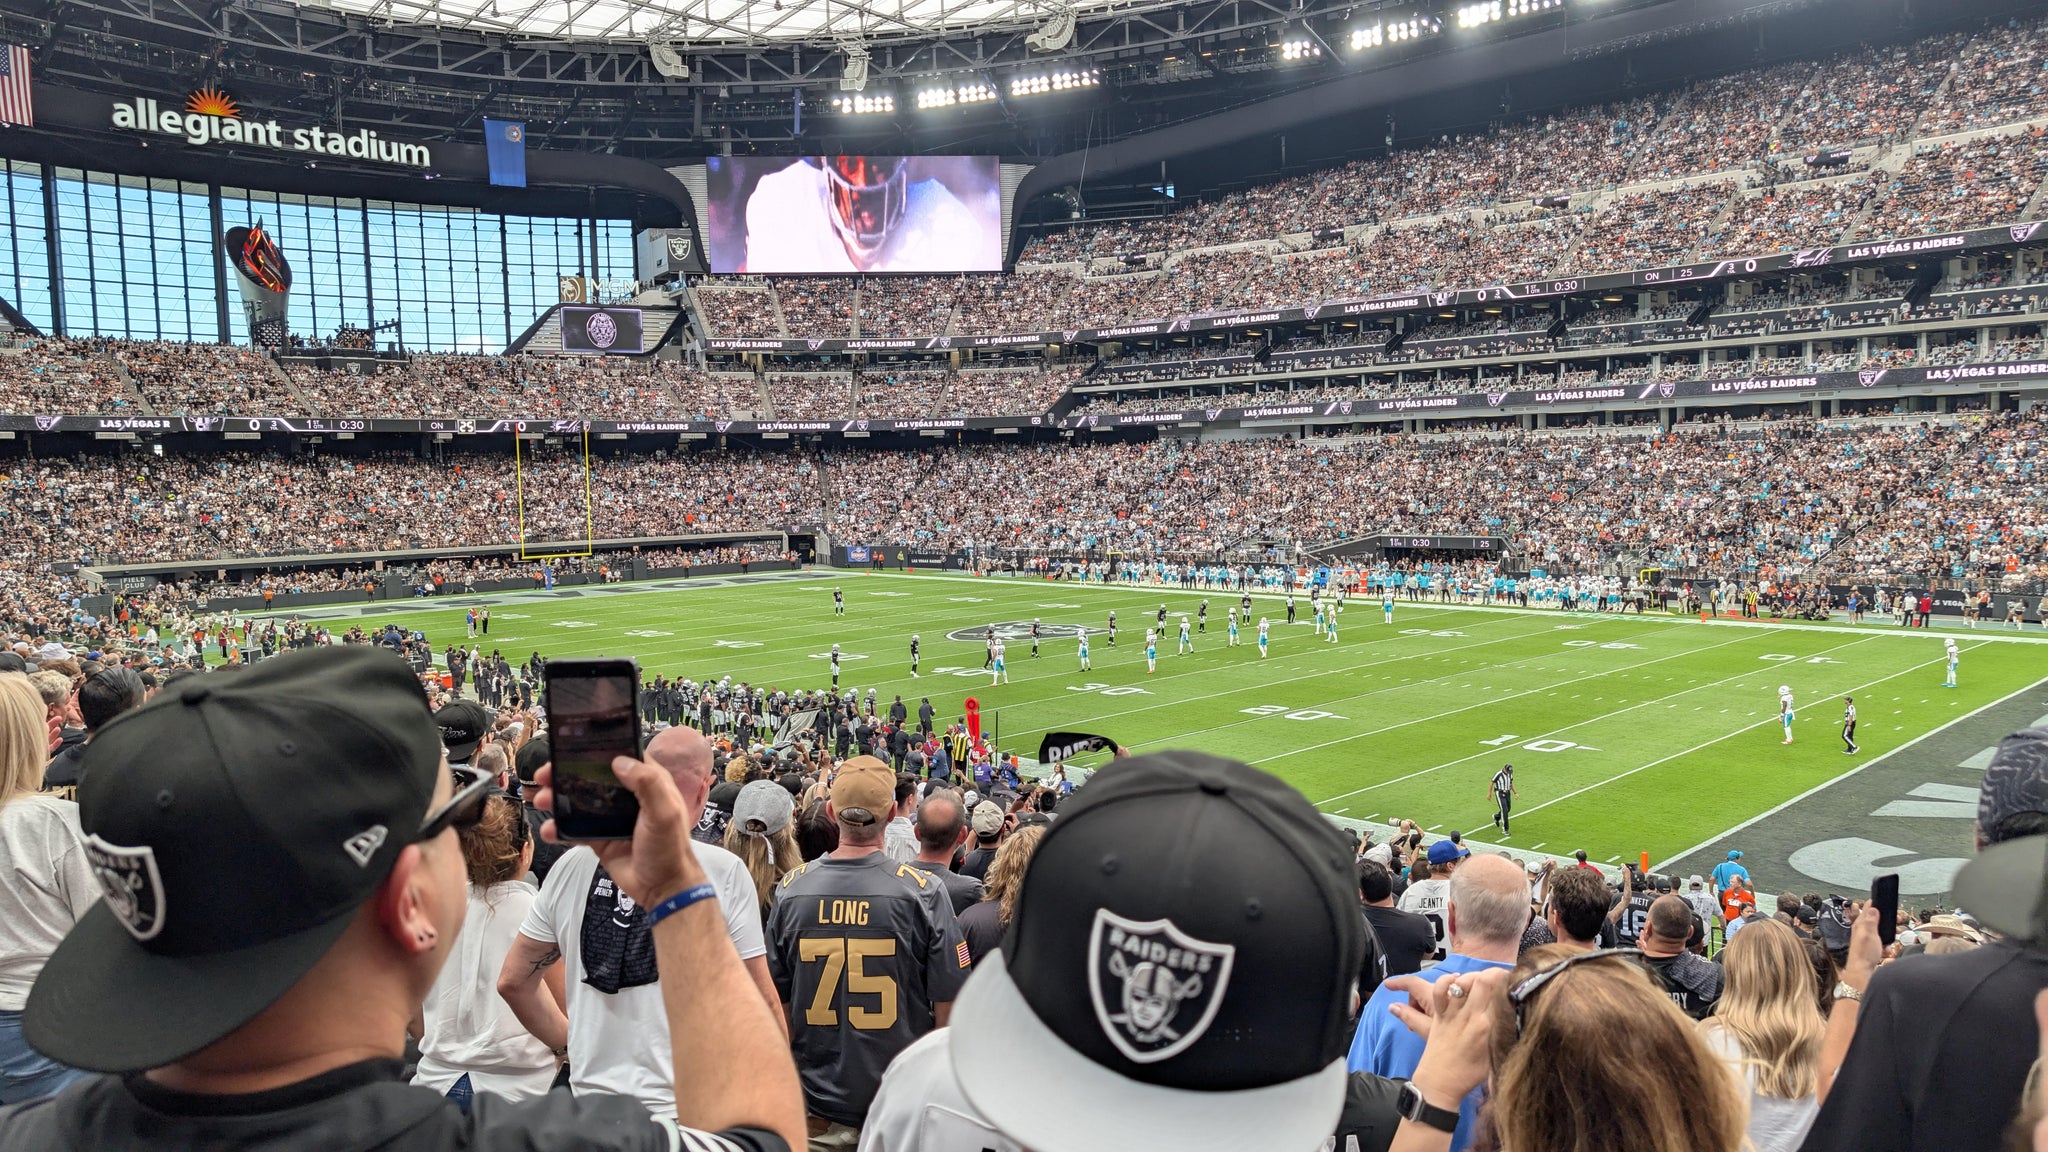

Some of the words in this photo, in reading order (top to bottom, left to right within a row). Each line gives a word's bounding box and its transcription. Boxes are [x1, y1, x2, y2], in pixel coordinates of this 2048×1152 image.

[112, 97, 282, 145] allegiant
[293, 126, 430, 167] stadium
[1848, 247, 1869, 258] LAS
[1872, 242, 1910, 255] VEGAS
[1912, 236, 1964, 250] RAIDERS
[1746, 260, 1757, 272] 0
[1645, 272, 1659, 281] ON
[1680, 269, 1693, 278] 25
[590, 278, 639, 295] MGM
[1525, 285, 1530, 294] 1
[1554, 281, 1577, 291] 0:30
[1478, 290, 1486, 300] 0
[1360, 302, 1384, 311] VEGAS
[1386, 299, 1418, 309] RAIDERS
[1228, 316, 1249, 324] VEGAS
[1251, 314, 1279, 322] RAIDERS
[1131, 325, 1158, 334] RAIDERS
[1926, 370, 1950, 379] LAS
[1952, 367, 1995, 378] VEGAS
[1998, 364, 2048, 375] RAIDER
[1712, 383, 1731, 391] LAS
[1734, 380, 1768, 390] VEGAS
[1770, 377, 1817, 388] RAIDERS
[1536, 392, 1552, 401] LAS
[1554, 391, 1584, 400] VEGAS
[1586, 388, 1625, 399] RAIDERS
[1379, 401, 1399, 409] LAS
[1401, 400, 1421, 408] VEGAS
[1422, 398, 1457, 407] RAIDERS
[1258, 408, 1281, 416] VEGAS
[1282, 406, 1313, 415] RAIDERS
[100, 420, 122, 428] LAS
[124, 420, 161, 428] VEGAS
[163, 420, 171, 428] R
[250, 420, 260, 430] 0
[306, 420, 312, 430] 1
[340, 420, 364, 430] 0:30
[459, 421, 474, 432] 25
[518, 422, 526, 432] 0
[1066, 683, 1145, 696] 30
[1239, 705, 1333, 720] 20
[1478, 735, 1578, 752] 10
[896, 863, 932, 889] 7
[1419, 897, 1443, 908] JEANTY
[818, 900, 869, 926] LONG
[1620, 908, 1648, 936] 16
[1109, 926, 1213, 974] RAIDERS
[799, 937, 898, 1030] 75
